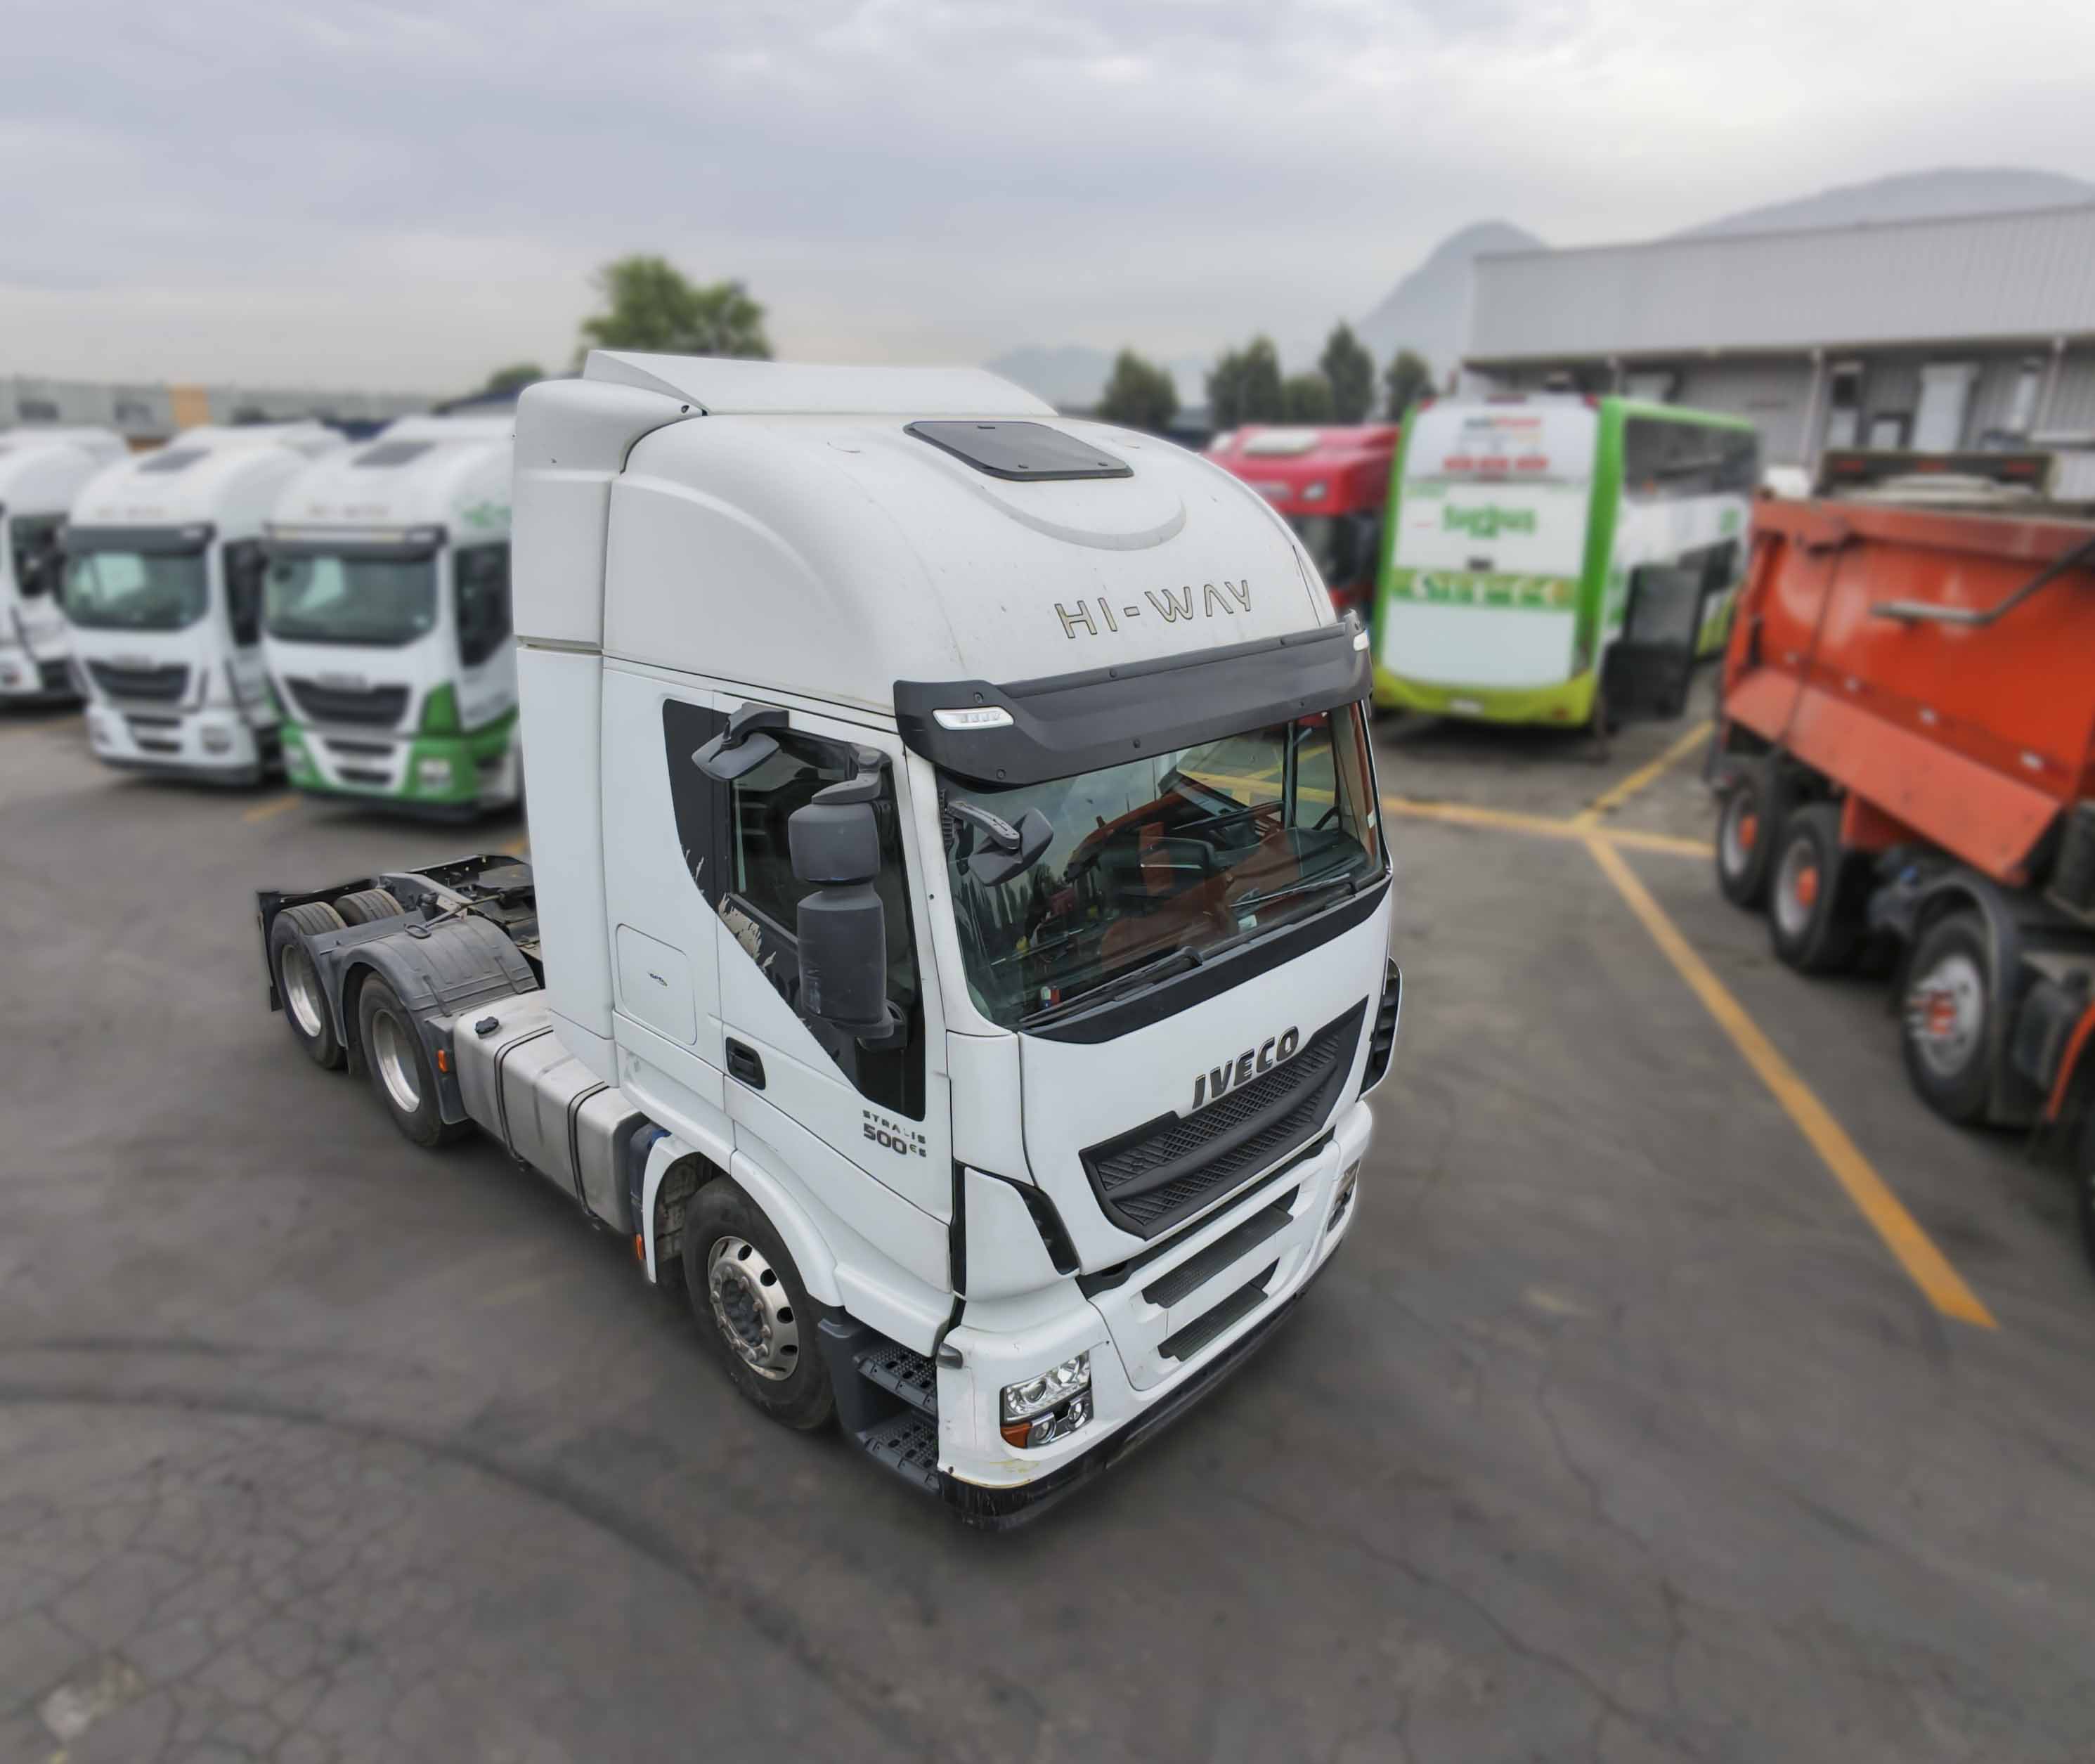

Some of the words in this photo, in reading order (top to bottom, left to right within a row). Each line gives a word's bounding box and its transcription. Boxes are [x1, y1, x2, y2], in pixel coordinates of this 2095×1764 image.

[1054, 580, 1252, 639] HI-WAY
[1192, 1025, 1299, 1110] IVECO
[862, 1110, 926, 1144] STRALIS
